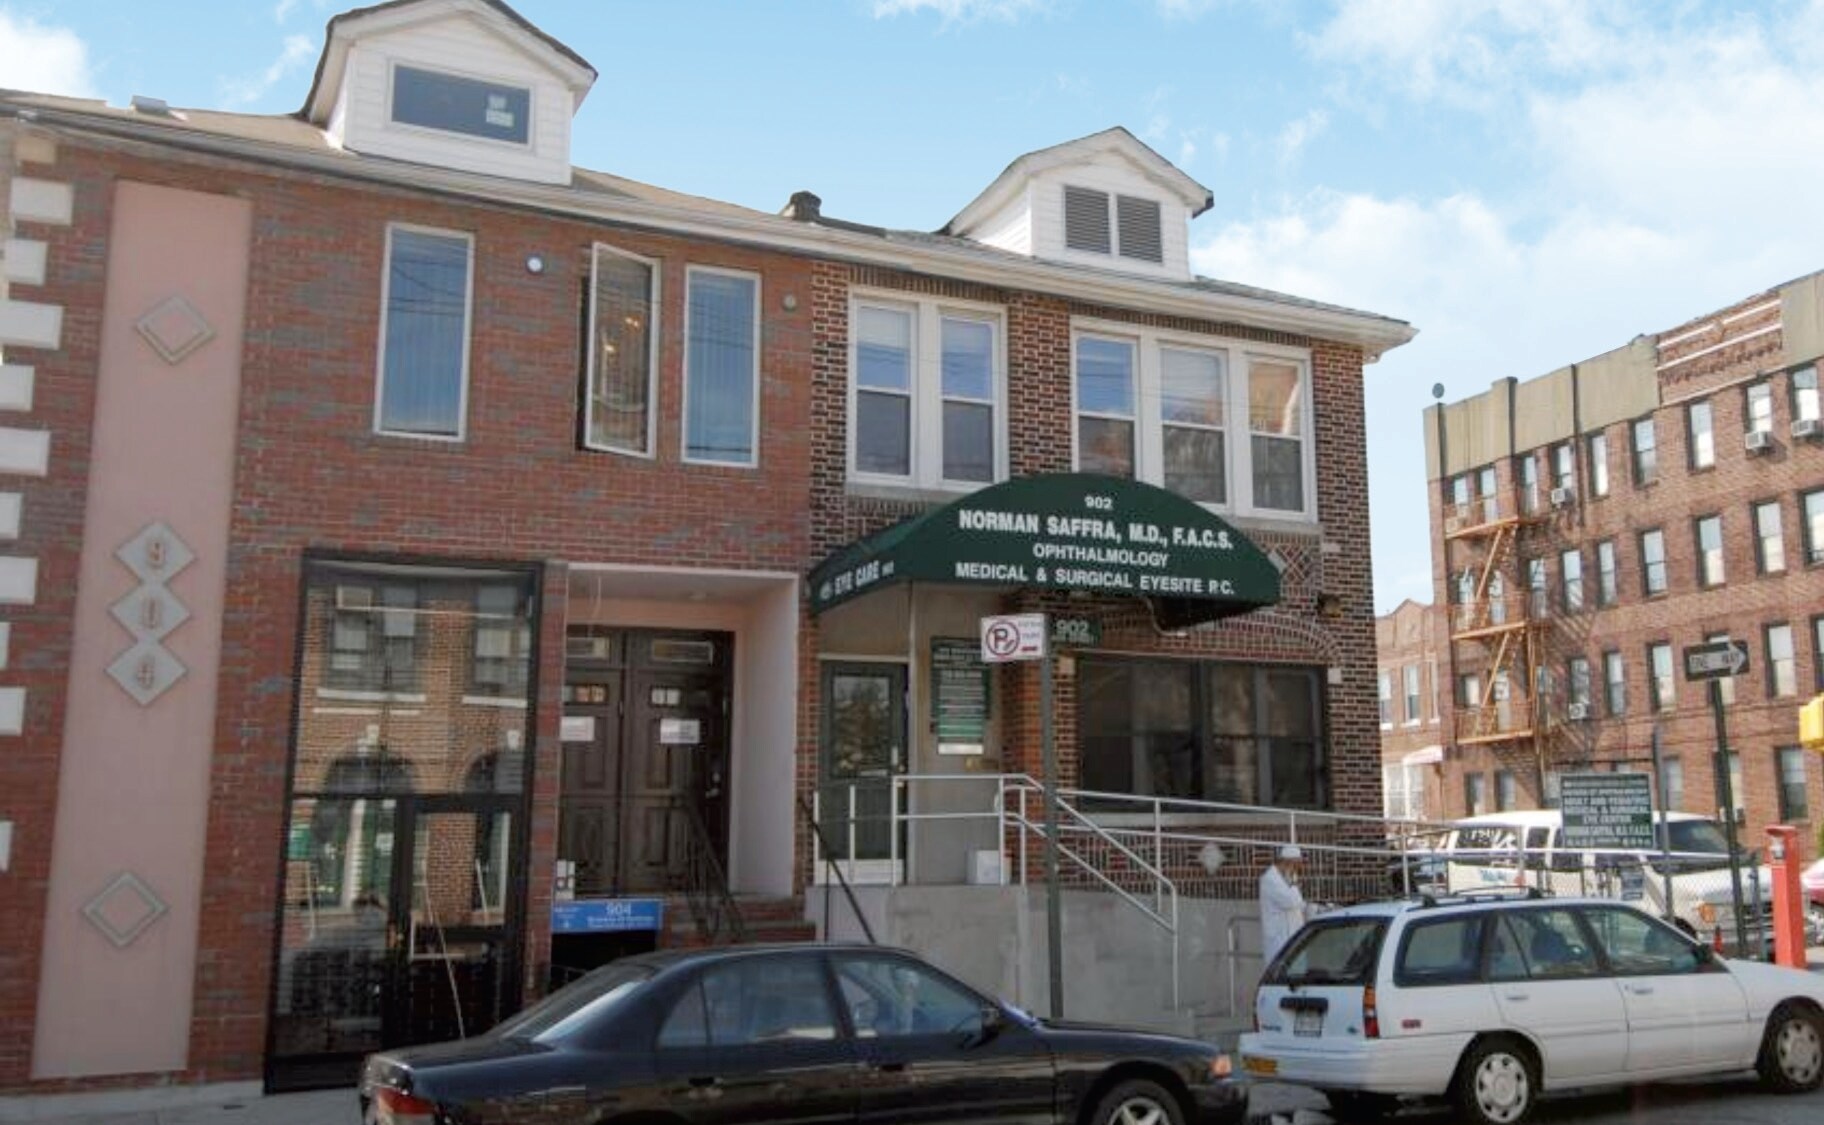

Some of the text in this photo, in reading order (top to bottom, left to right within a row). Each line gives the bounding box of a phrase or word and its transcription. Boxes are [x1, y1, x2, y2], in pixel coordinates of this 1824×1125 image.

[1084, 496, 1114, 510] 902
[959, 508, 1234, 550] NORMAN SAFFRA, M.D., F.A.C.S.
[1033, 543, 1169, 568] OPHTHALMOLOGY
[955, 562, 1029, 582] MEDICAL
[1036, 567, 1047, 583] &
[1055, 568, 1133, 589] SURGICAL
[1140, 575, 1204, 593] EYESITE
[1056, 619, 1089, 637] 902
